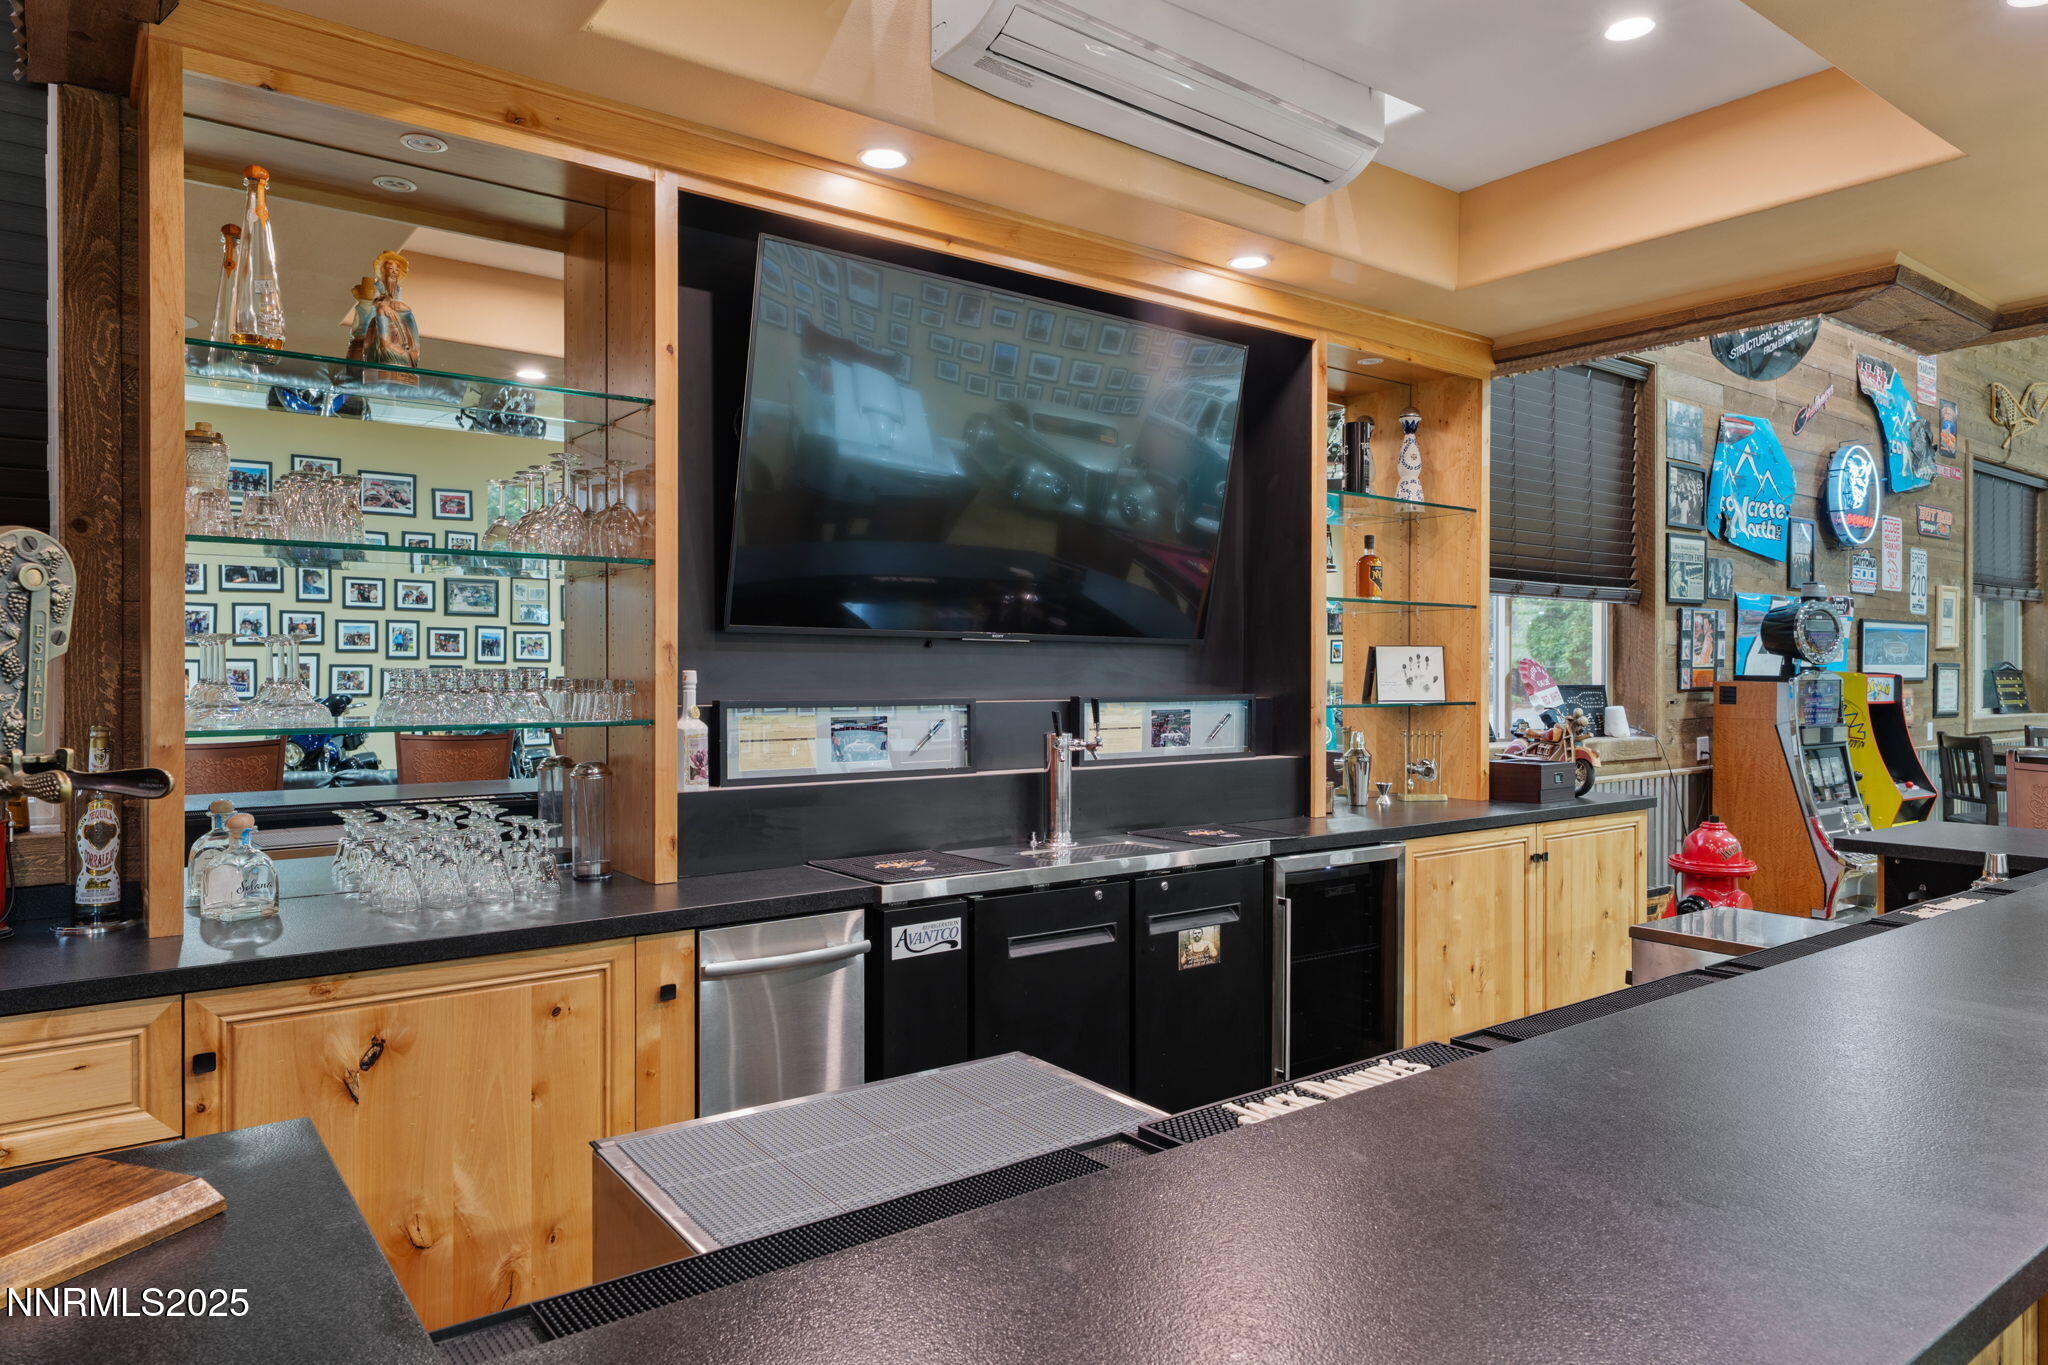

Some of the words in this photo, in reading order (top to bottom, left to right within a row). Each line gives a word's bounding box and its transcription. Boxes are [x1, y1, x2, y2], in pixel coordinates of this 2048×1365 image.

[1728, 330, 1774, 360] STRUCTURAL
[1763, 340, 1778, 355] FROM
[1884, 542, 1901, 552] PARKING
[1853, 555, 1877, 569] DAYTONA
[1911, 551, 1928, 564] SPEED
[1852, 568, 1877, 581] 500
[1912, 563, 1926, 575] LIMIT
[1911, 575, 1927, 597] 210
[32, 624, 44, 721] ESTATE
[88, 808, 113, 823] TEQUILA
[83, 848, 116, 868] CORRALEJO
[236, 879, 273, 895] Solana
[922, 920, 959, 930] REFRIGERATION
[894, 926, 960, 952] AVANTCO
